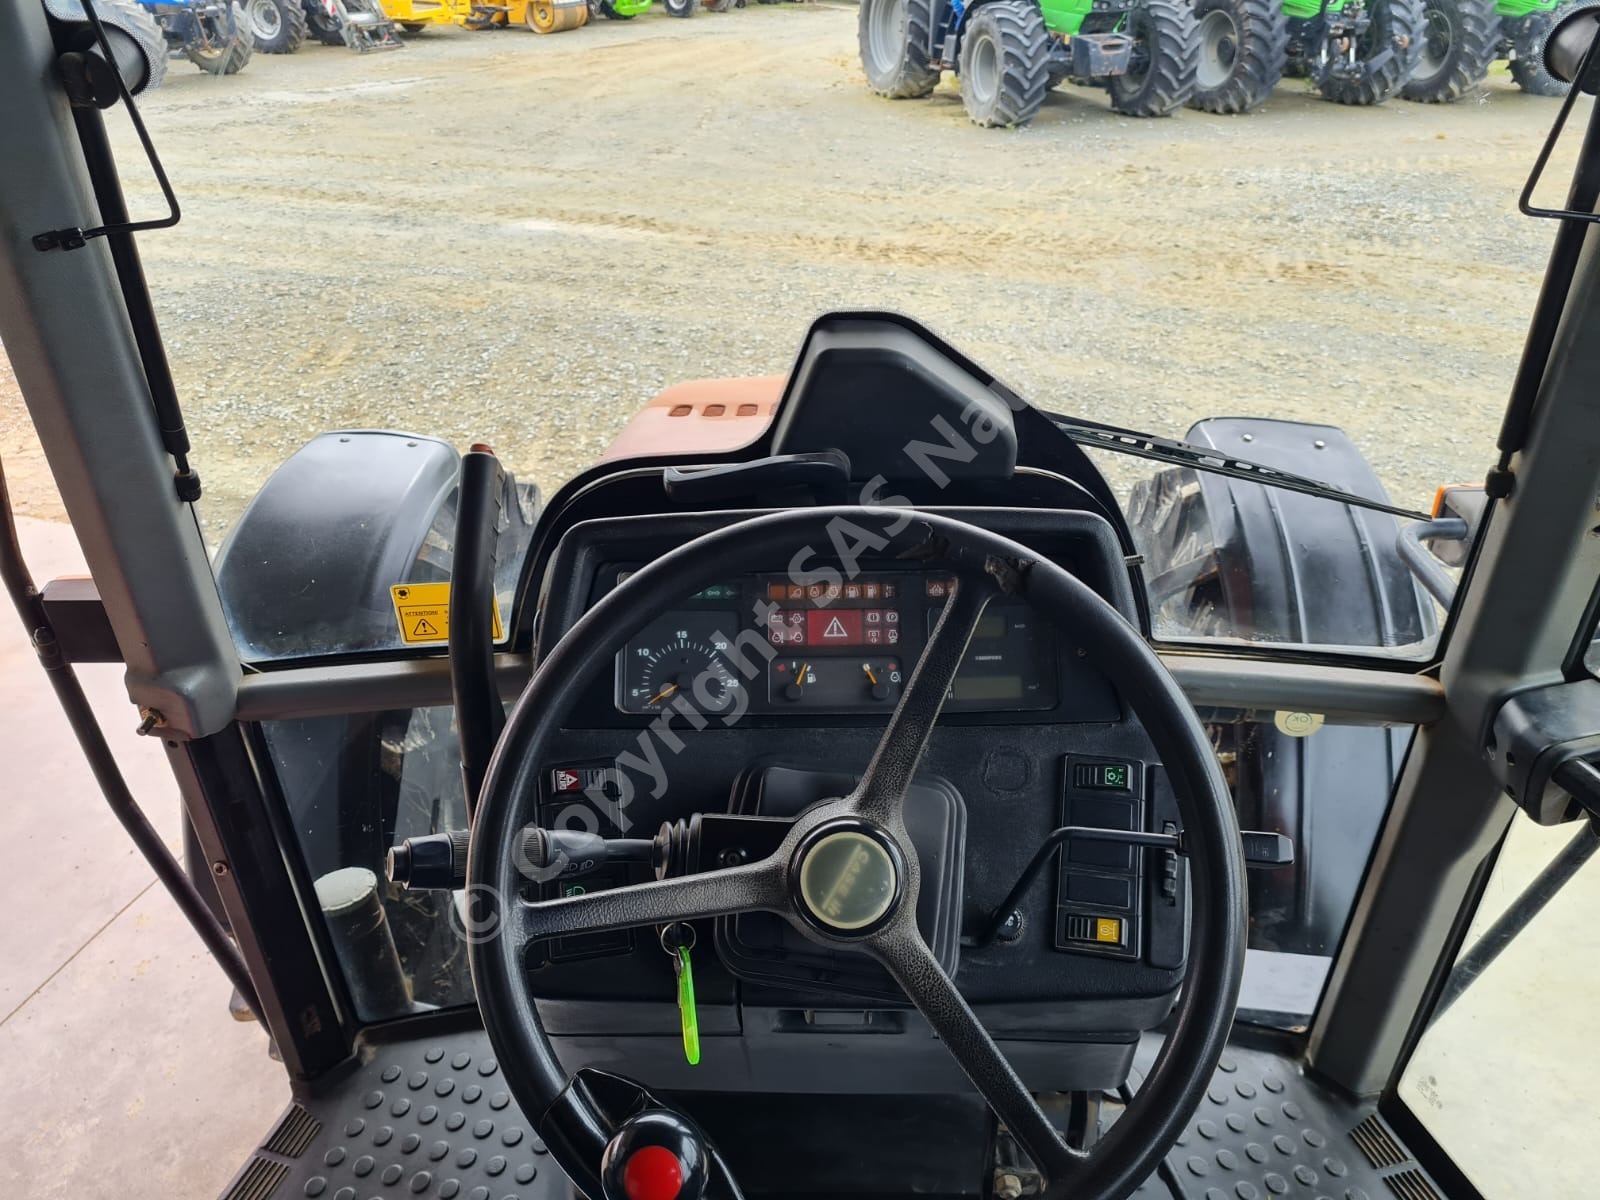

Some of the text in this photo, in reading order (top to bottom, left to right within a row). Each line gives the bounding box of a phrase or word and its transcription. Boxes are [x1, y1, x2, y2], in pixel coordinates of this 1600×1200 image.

[676, 631, 687, 639] 15
[715, 642, 727, 650] 20
[637, 648, 650, 656] 10
[726, 679, 739, 688] 25
[632, 689, 639, 697] 5
